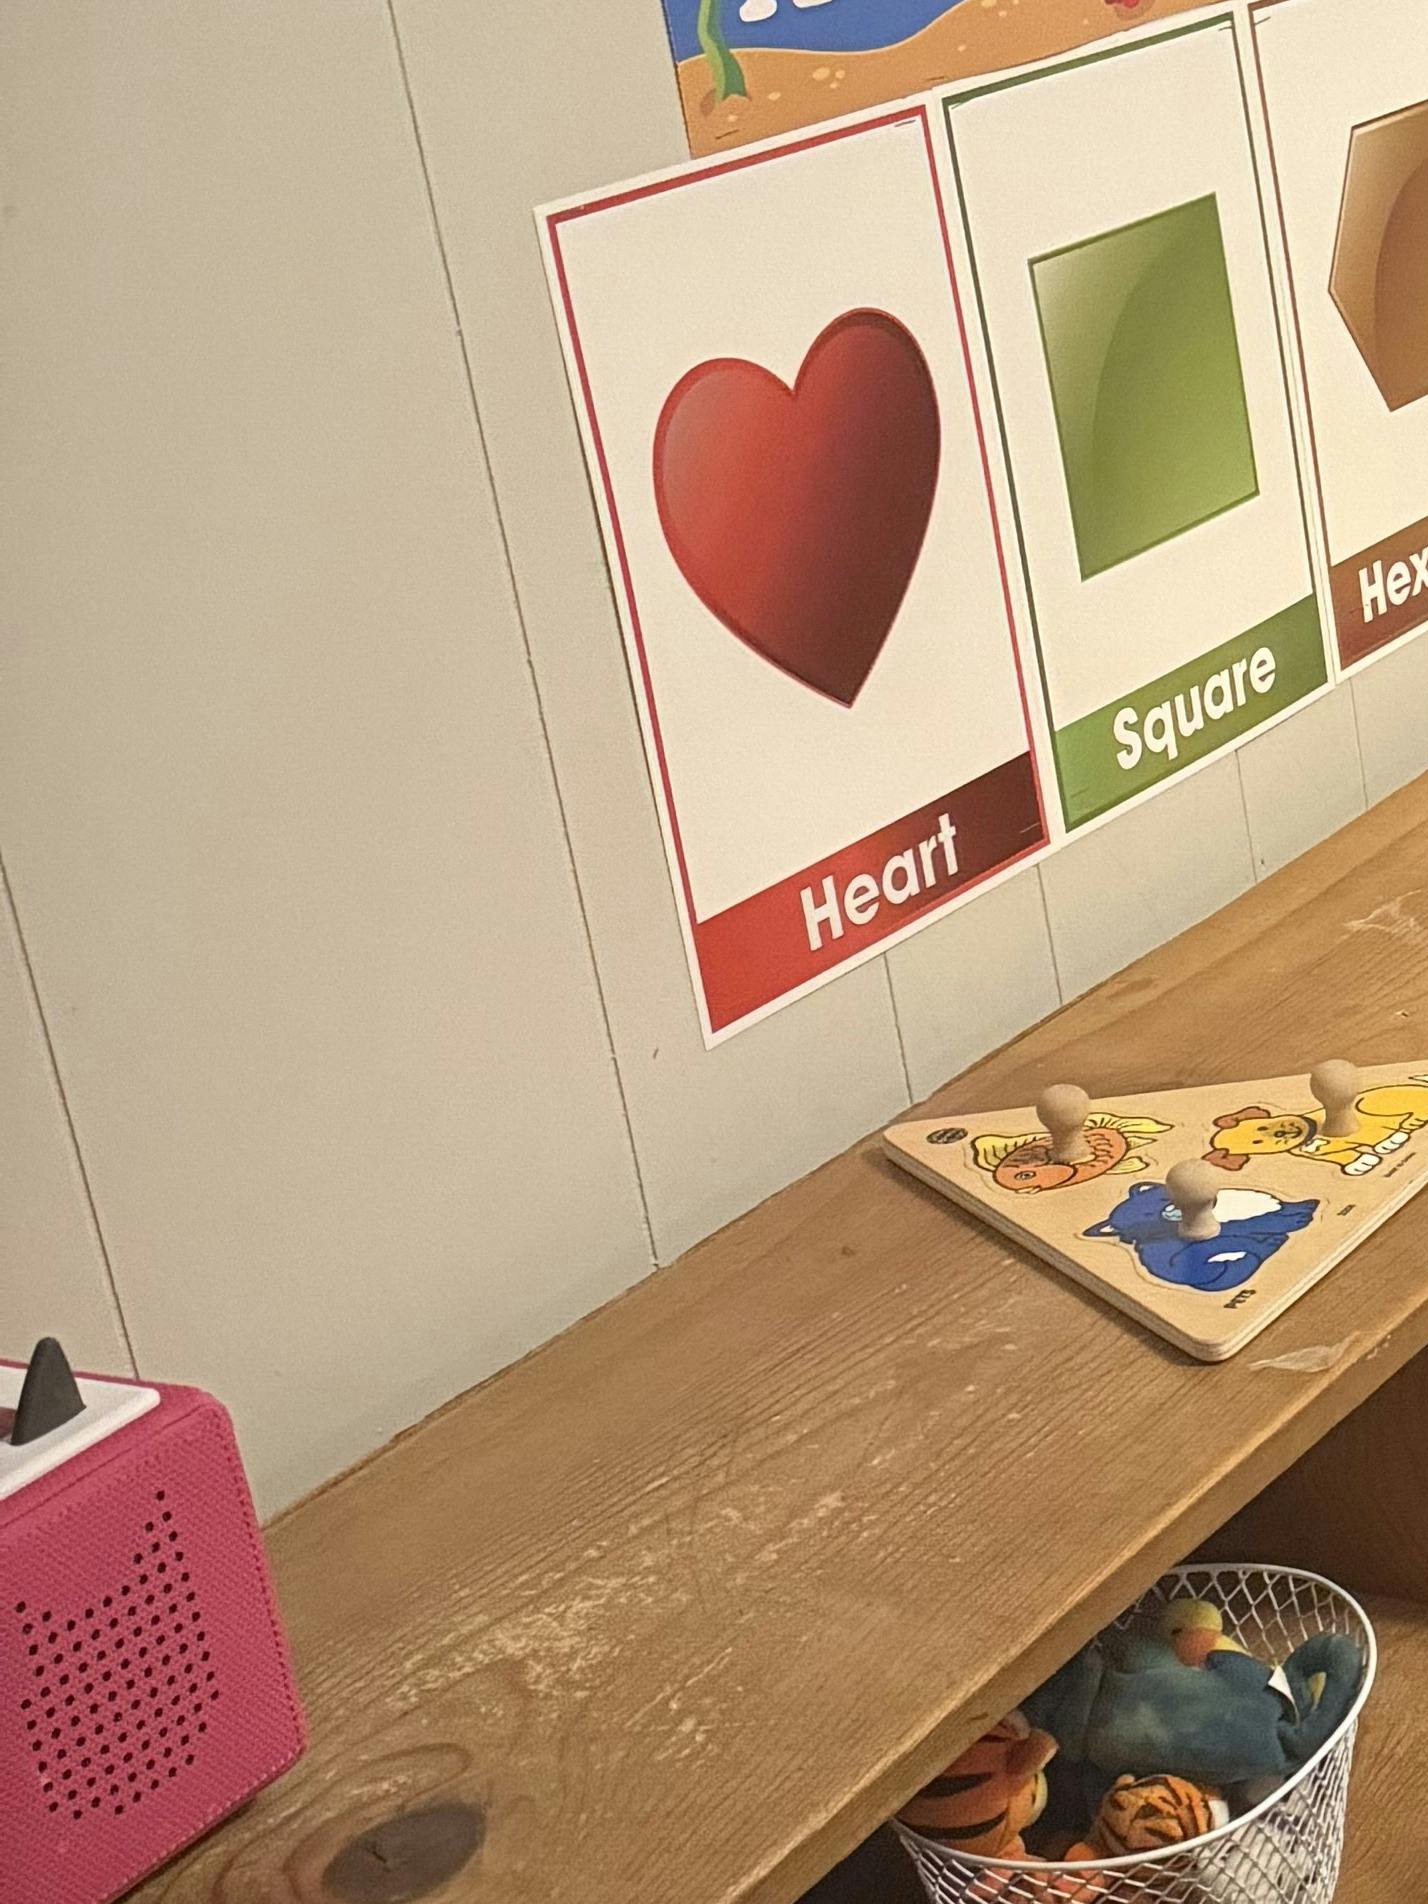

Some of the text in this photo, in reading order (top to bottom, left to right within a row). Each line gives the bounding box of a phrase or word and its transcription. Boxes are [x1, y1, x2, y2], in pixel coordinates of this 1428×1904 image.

[1112, 645, 1276, 770] Square
[800, 814, 958, 952] Heart
[1223, 1288, 1257, 1310] PETS
